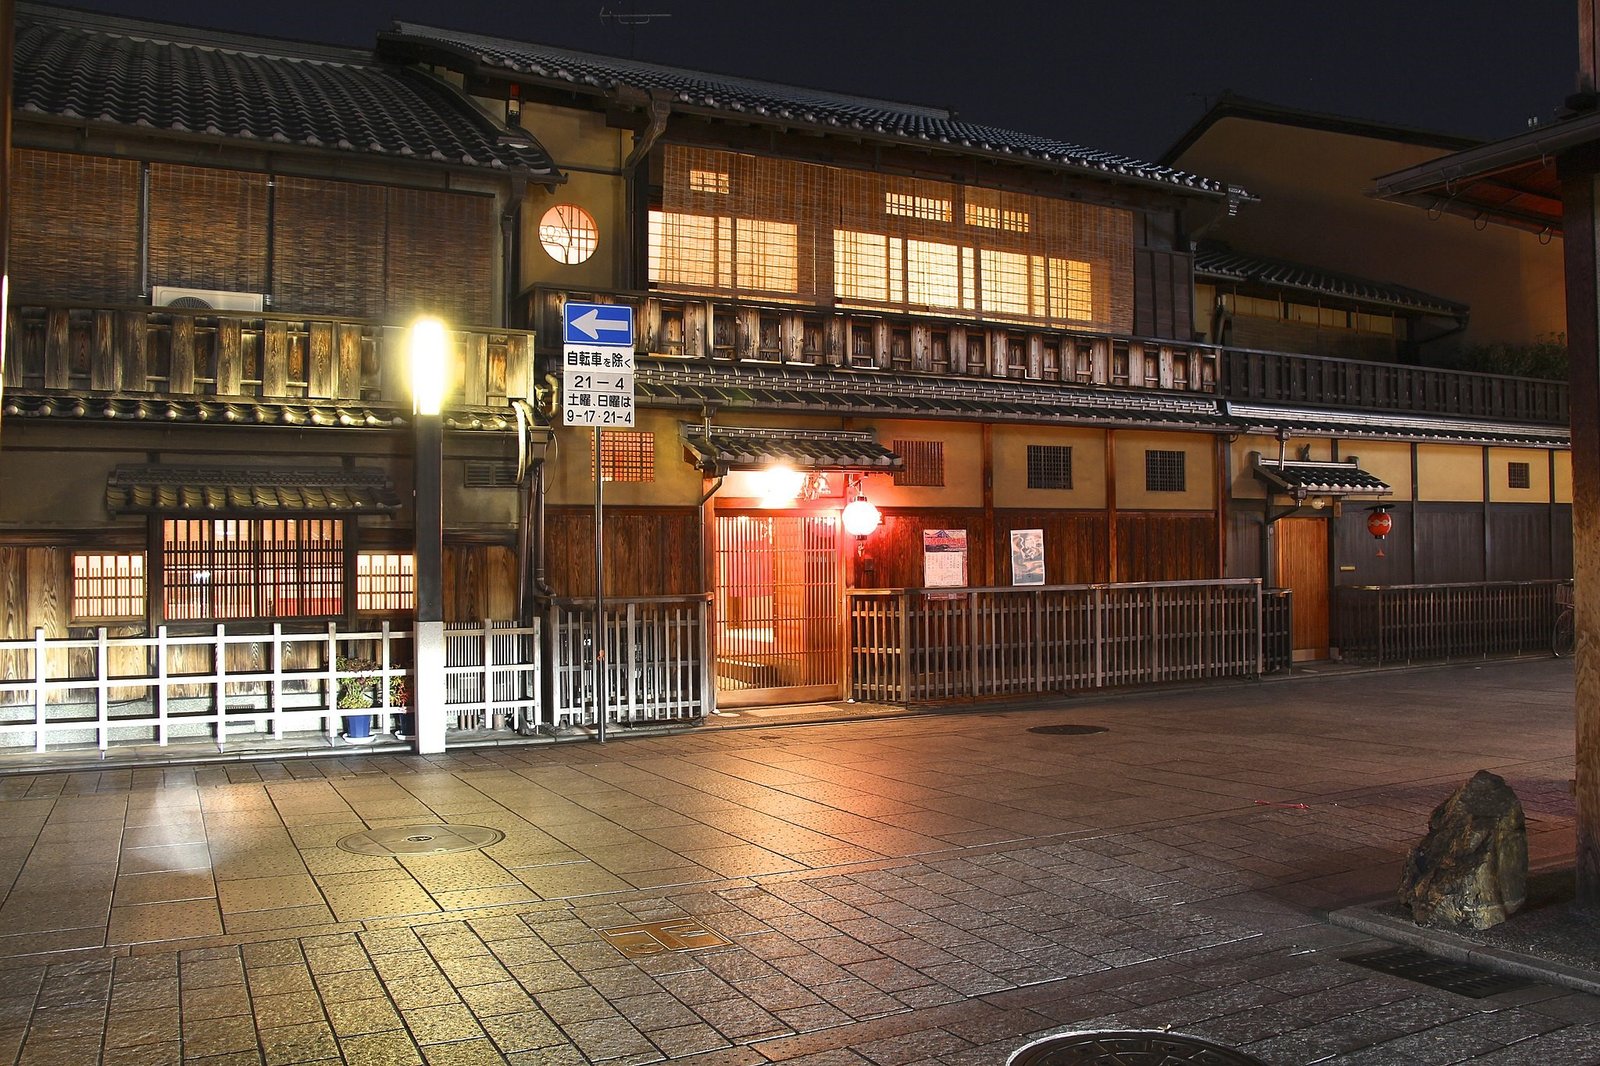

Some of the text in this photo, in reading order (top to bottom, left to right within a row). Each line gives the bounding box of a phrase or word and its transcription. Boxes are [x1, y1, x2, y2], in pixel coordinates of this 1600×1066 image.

[567, 351, 631, 368] 自転車を除く
[567, 393, 631, 407] 土曜、日曜は
